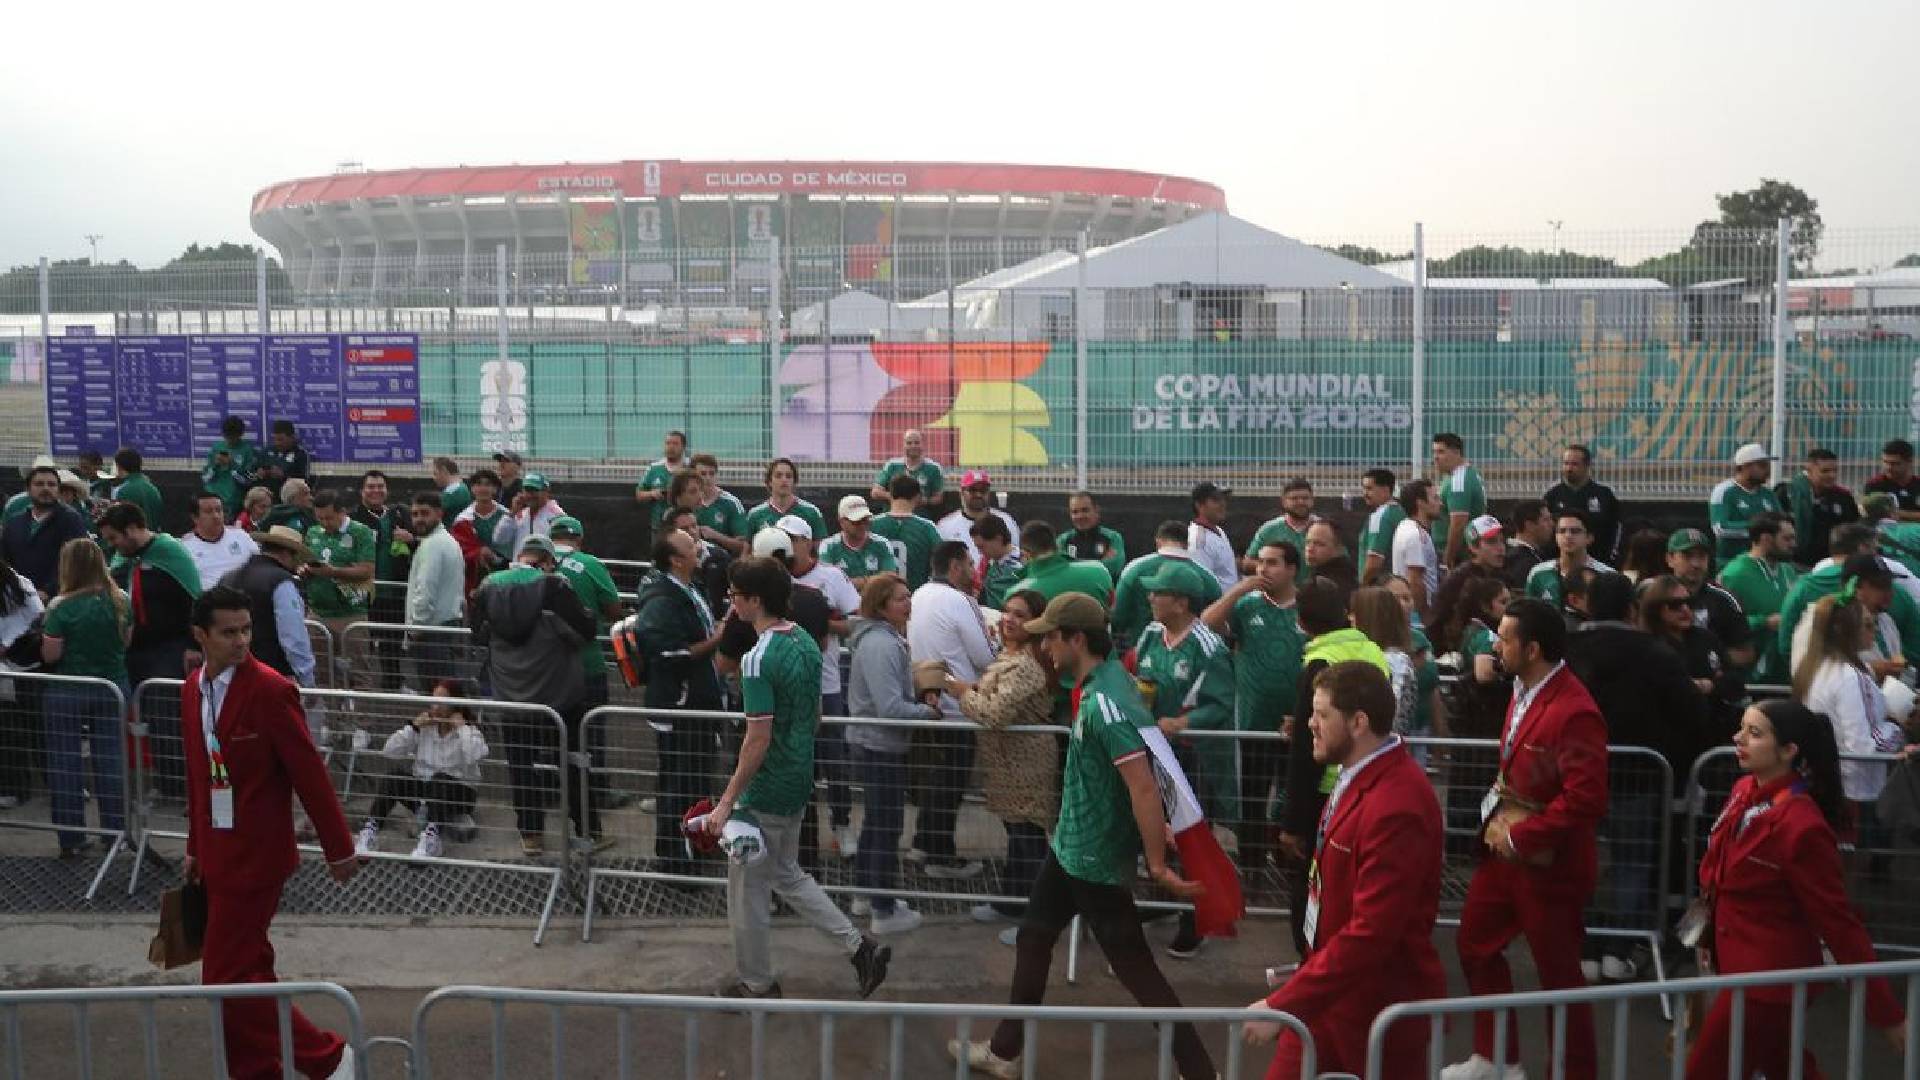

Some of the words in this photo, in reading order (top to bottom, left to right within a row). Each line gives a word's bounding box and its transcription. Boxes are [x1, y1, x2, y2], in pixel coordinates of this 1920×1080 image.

[538, 175, 614, 188] ESTADIO
[706, 173, 783, 186] CIUDAD
[793, 172, 820, 186] DE
[827, 169, 907, 186] MÉXICO
[1155, 374, 1242, 399] COPA
[1249, 373, 1392, 399] MUNDIAL
[1133, 405, 1172, 429] DE
[1180, 405, 1220, 429] LA
[1228, 405, 1295, 429] FIFA
[1301, 404, 1412, 429] 2026
